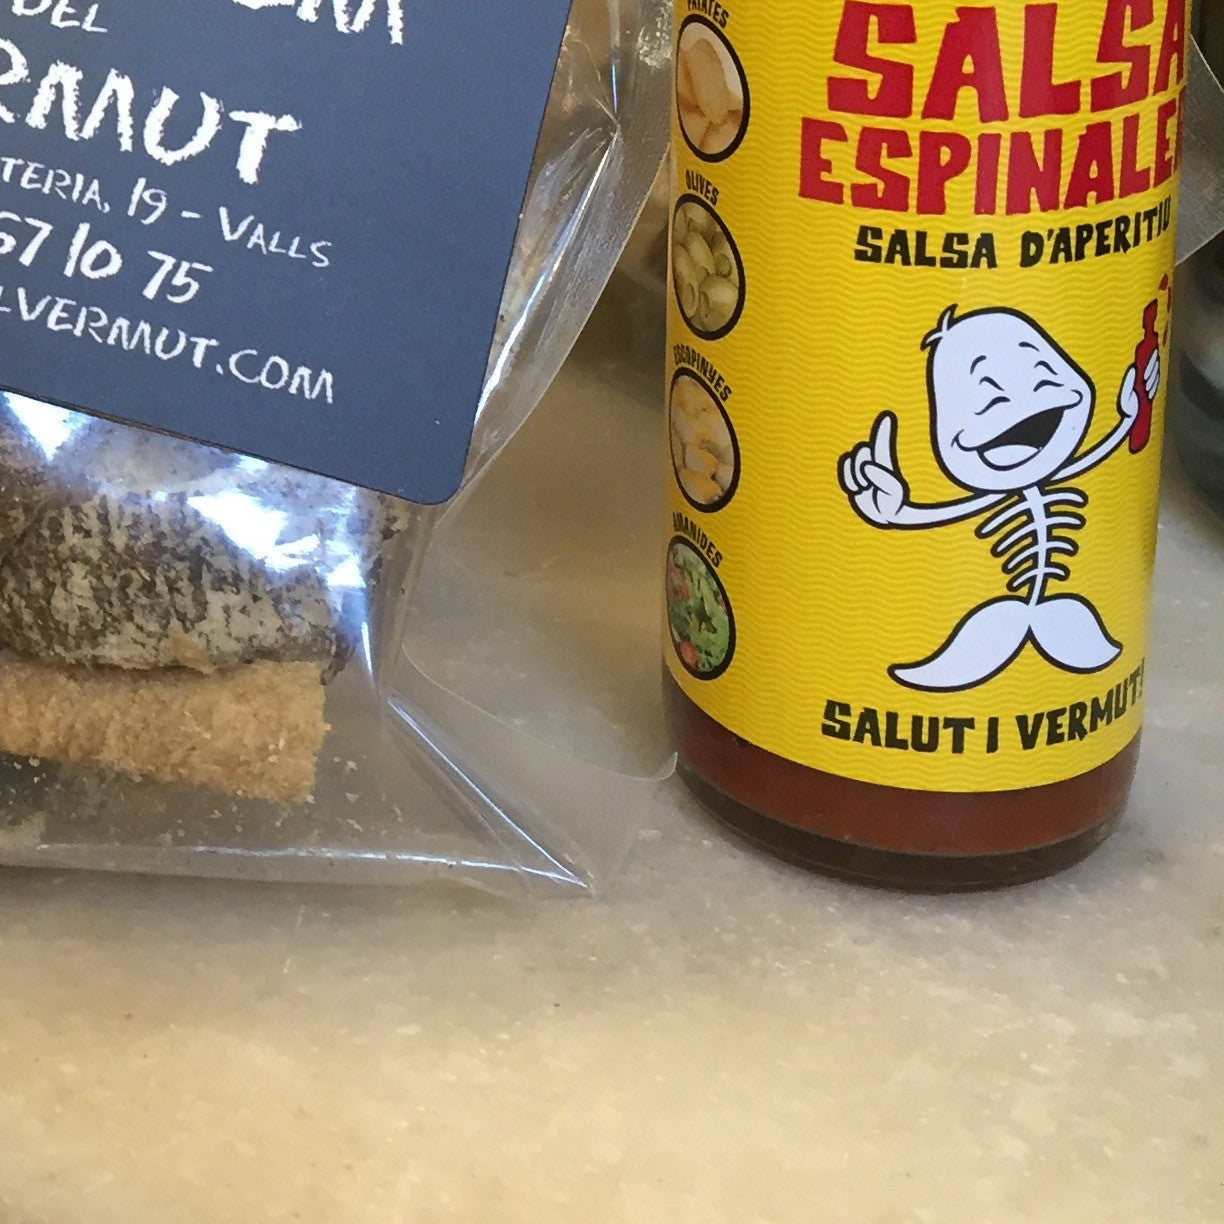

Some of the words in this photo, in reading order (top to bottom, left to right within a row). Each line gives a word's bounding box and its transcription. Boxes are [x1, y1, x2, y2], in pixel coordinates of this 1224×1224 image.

[798, 84, 1186, 216] ESPINALE
[127, 177, 167, 225] 19
[218, 206, 333, 268] VALLS
[684, 169, 721, 207] OLIVES
[63, 222, 123, 280] 10
[142, 250, 214, 304] 75
[853, 224, 999, 269] SALSA
[820, 698, 976, 755] SALUT
[985, 716, 1000, 754] I
